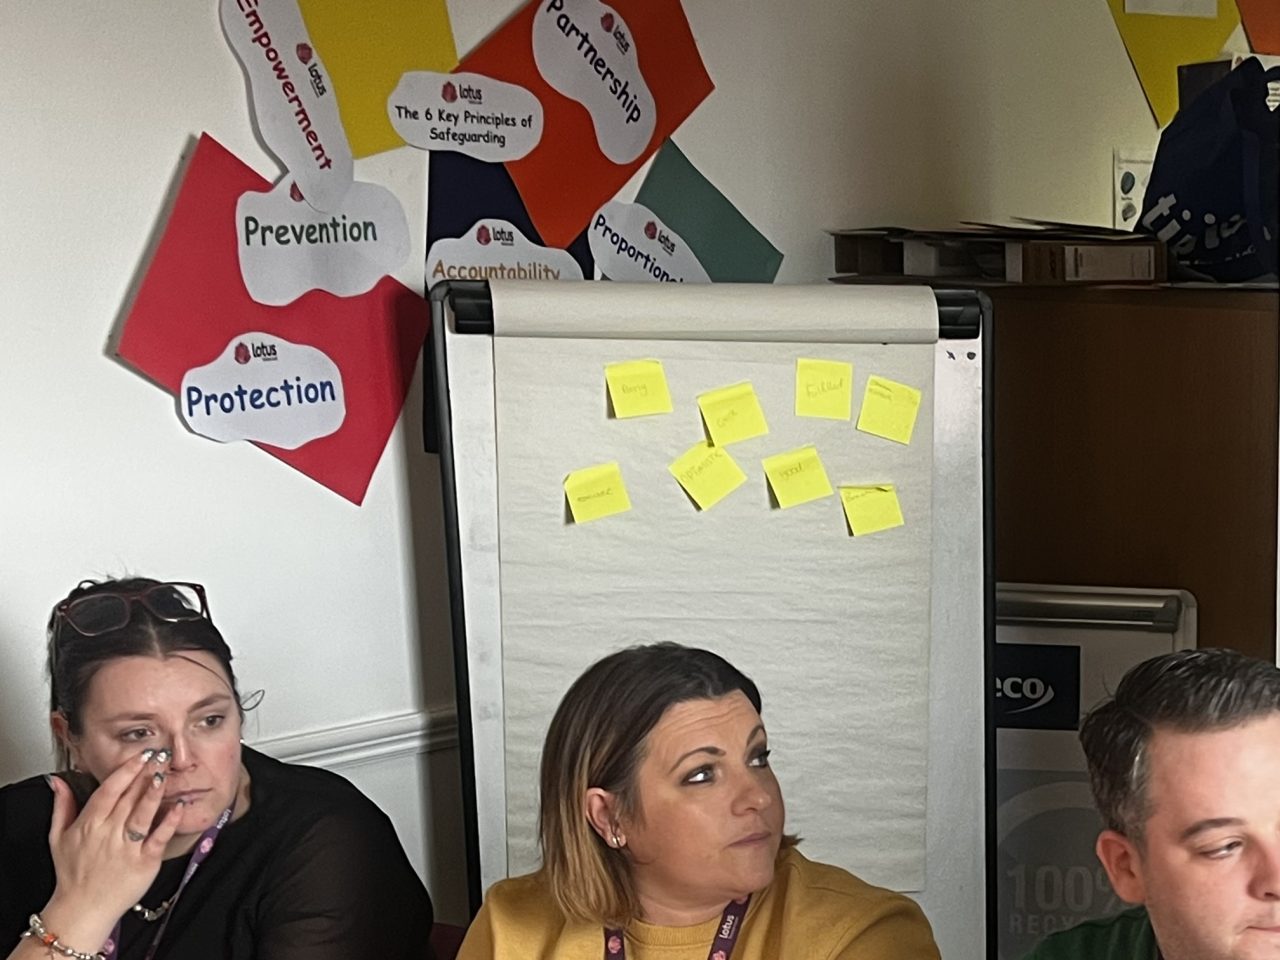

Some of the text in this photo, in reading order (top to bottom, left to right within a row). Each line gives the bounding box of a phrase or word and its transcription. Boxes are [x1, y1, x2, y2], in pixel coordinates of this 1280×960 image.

[546, 0, 641, 124] Partnership
[237, 0, 332, 170] Empowerment
[459, 84, 482, 101] lotus
[395, 105, 533, 128] The 6 Key Principles of
[429, 127, 506, 147] Safeguarding
[245, 214, 378, 246] Prevention
[492, 227, 514, 242] lotus
[594, 213, 683, 282] Proportion
[251, 343, 277, 358] lotus
[187, 376, 336, 417] Protection
[719, 915, 735, 939] lotus
